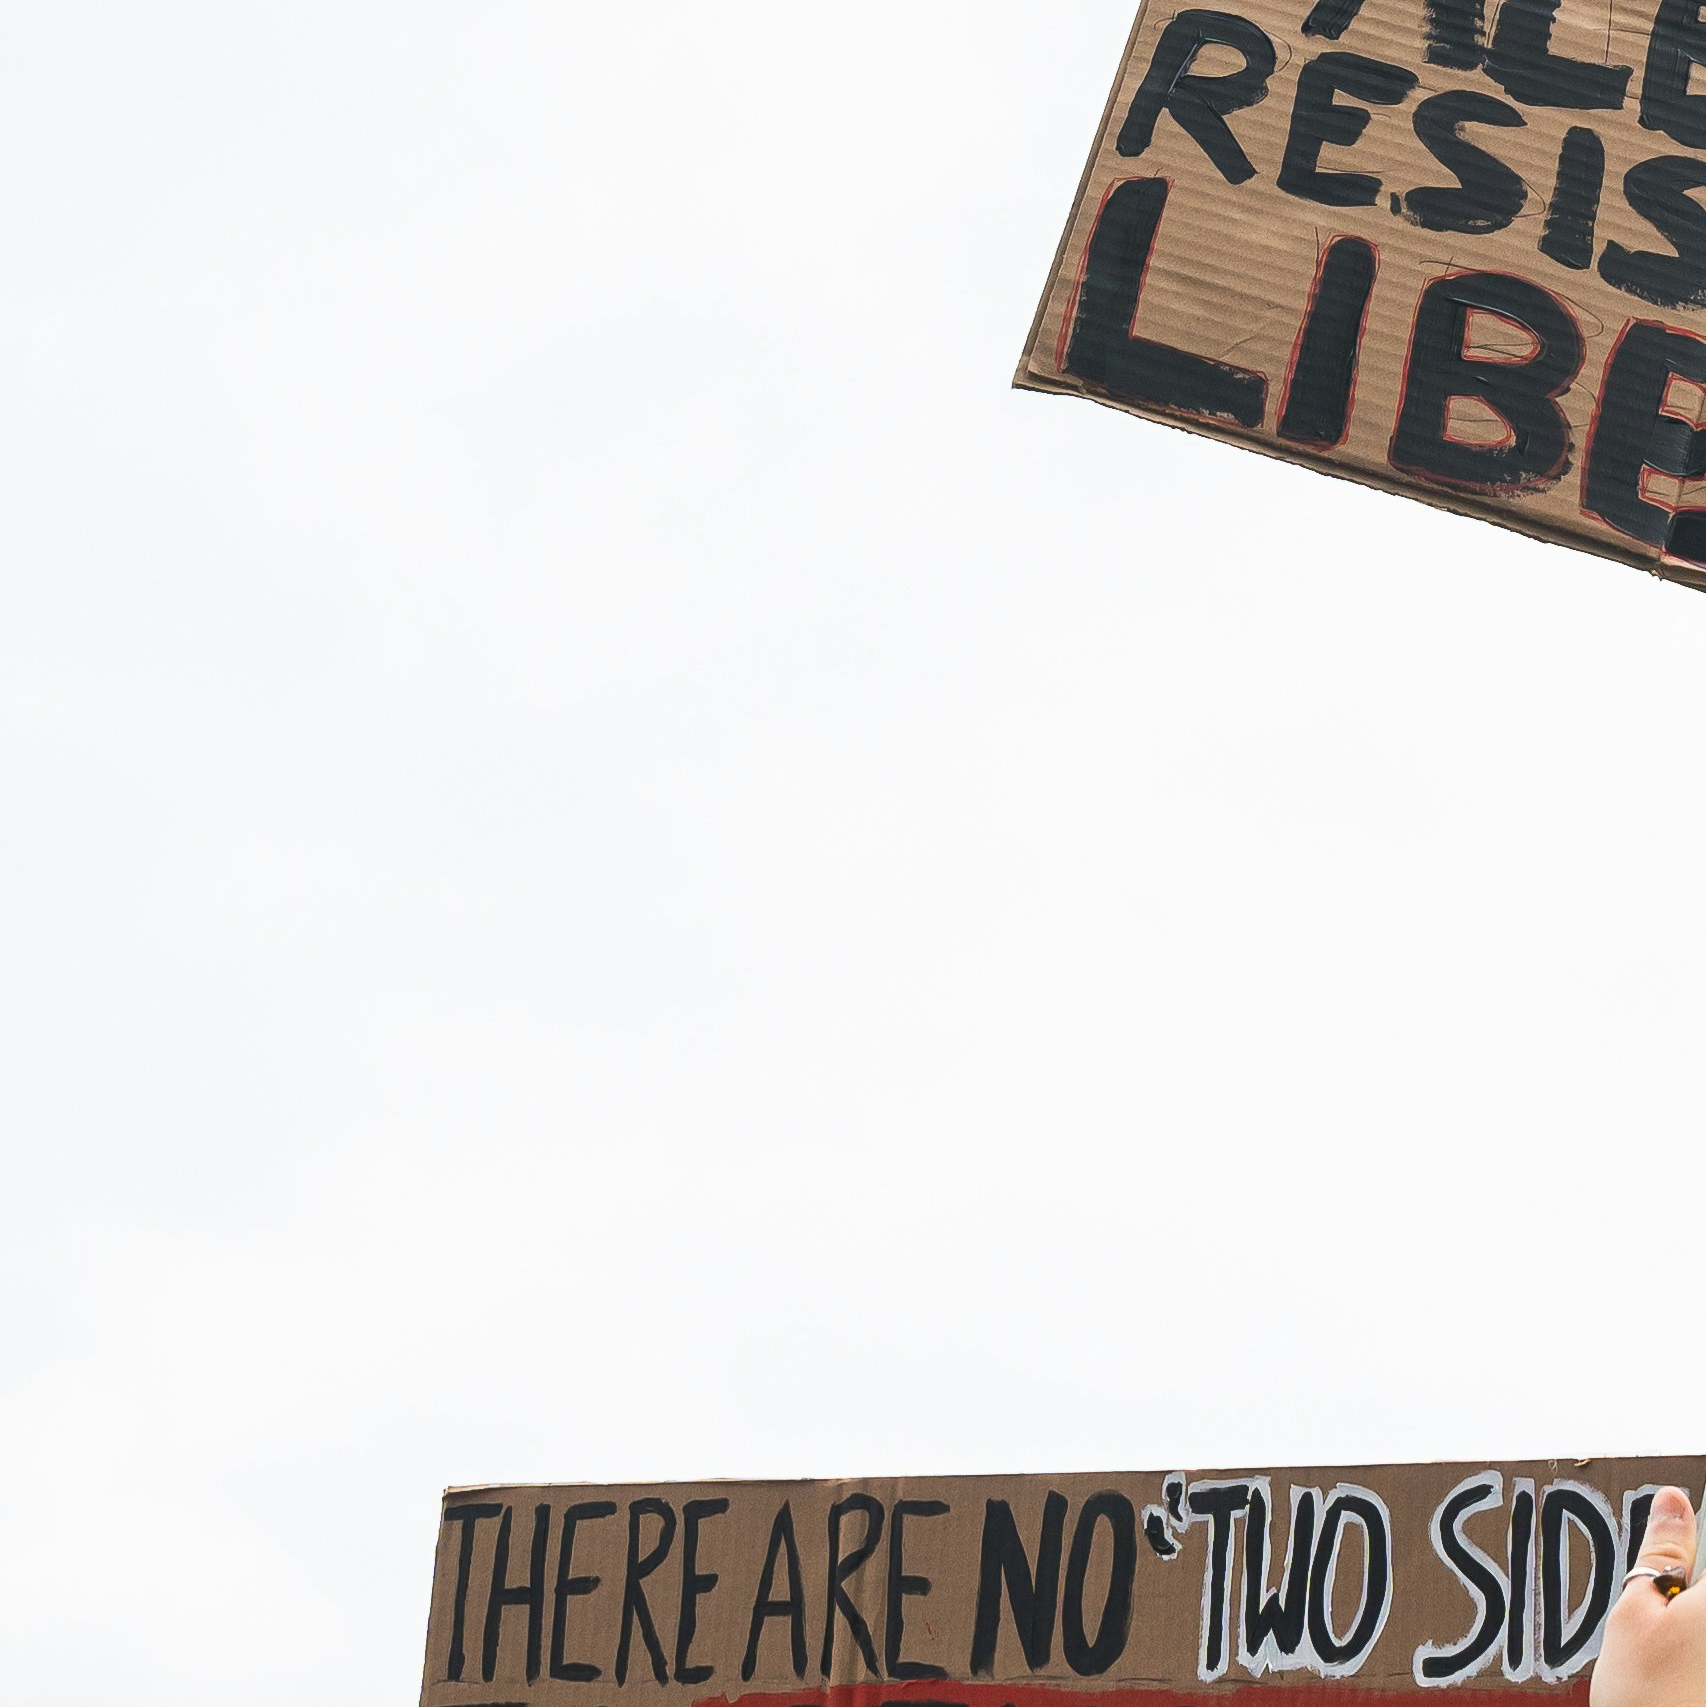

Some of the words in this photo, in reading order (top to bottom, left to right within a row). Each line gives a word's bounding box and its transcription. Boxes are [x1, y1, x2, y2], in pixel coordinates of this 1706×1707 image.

[444, 1498, 729, 1687] THERE
[742, 1493, 952, 1684] ARE
[969, 1490, 1137, 1677] NO
